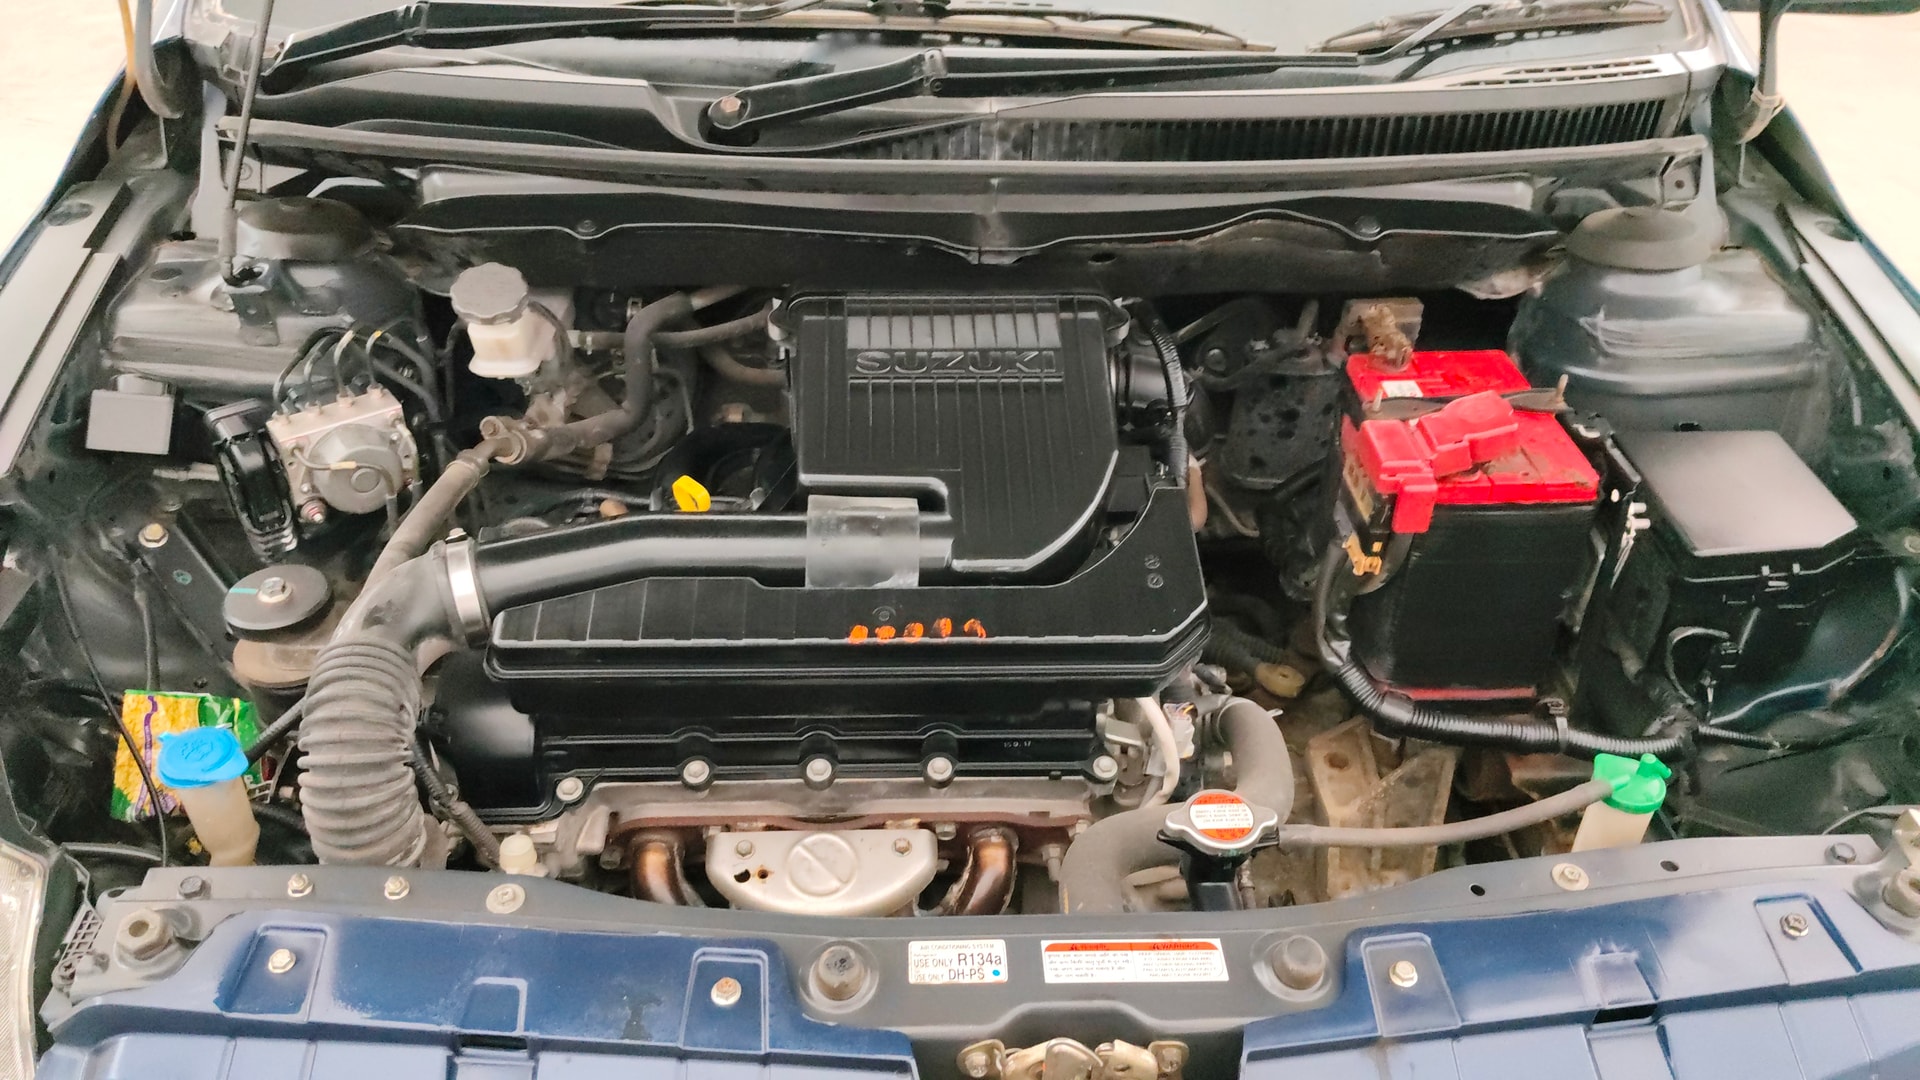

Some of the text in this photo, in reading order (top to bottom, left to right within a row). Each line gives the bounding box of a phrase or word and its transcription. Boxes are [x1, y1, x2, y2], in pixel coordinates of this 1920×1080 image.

[855, 350, 1056, 375] SUZUKI
[914, 952, 1002, 968] USE ONLY R134a
[914, 973, 926, 981] USE
[948, 967, 985, 980] DH-PS
